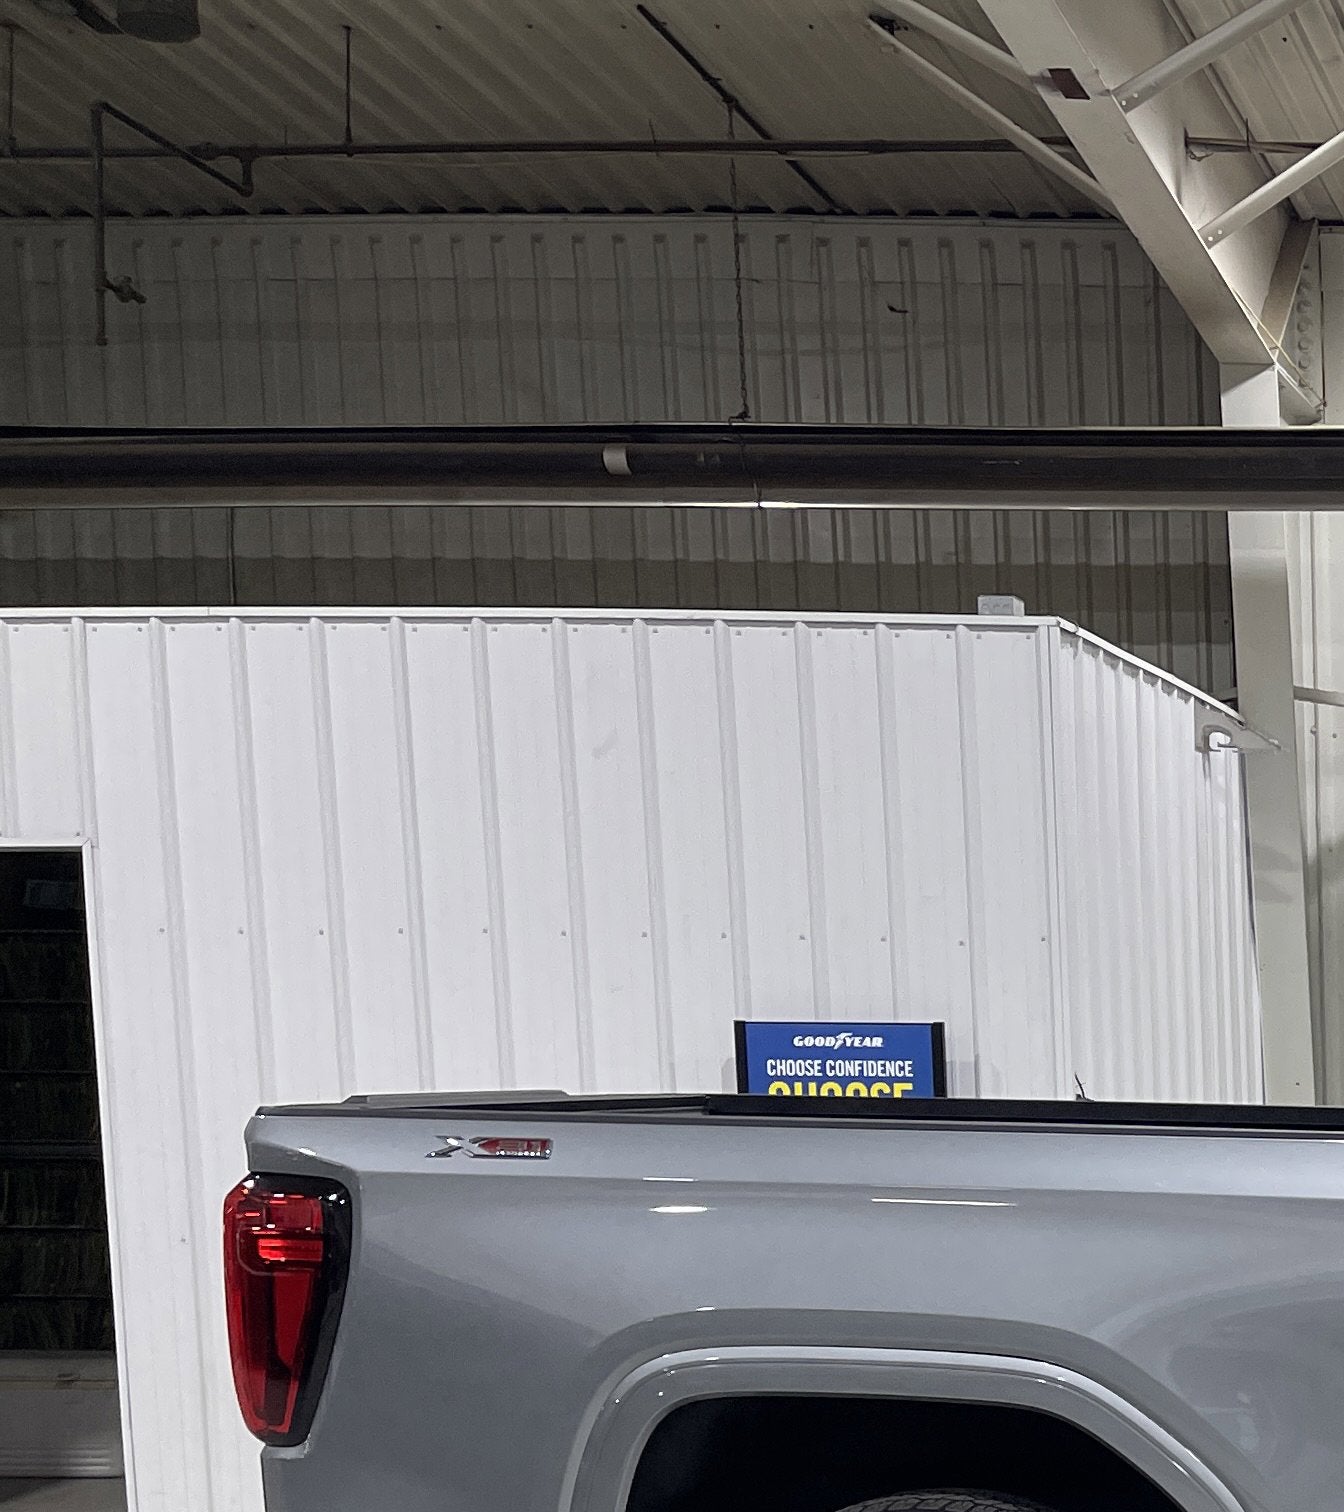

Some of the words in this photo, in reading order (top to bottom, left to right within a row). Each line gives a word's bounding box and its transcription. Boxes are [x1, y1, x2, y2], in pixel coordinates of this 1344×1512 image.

[793, 1032, 883, 1050] GOODYEAR
[767, 1059, 822, 1077] CHOOSE
[826, 1060, 913, 1078] CONFIDENCE
